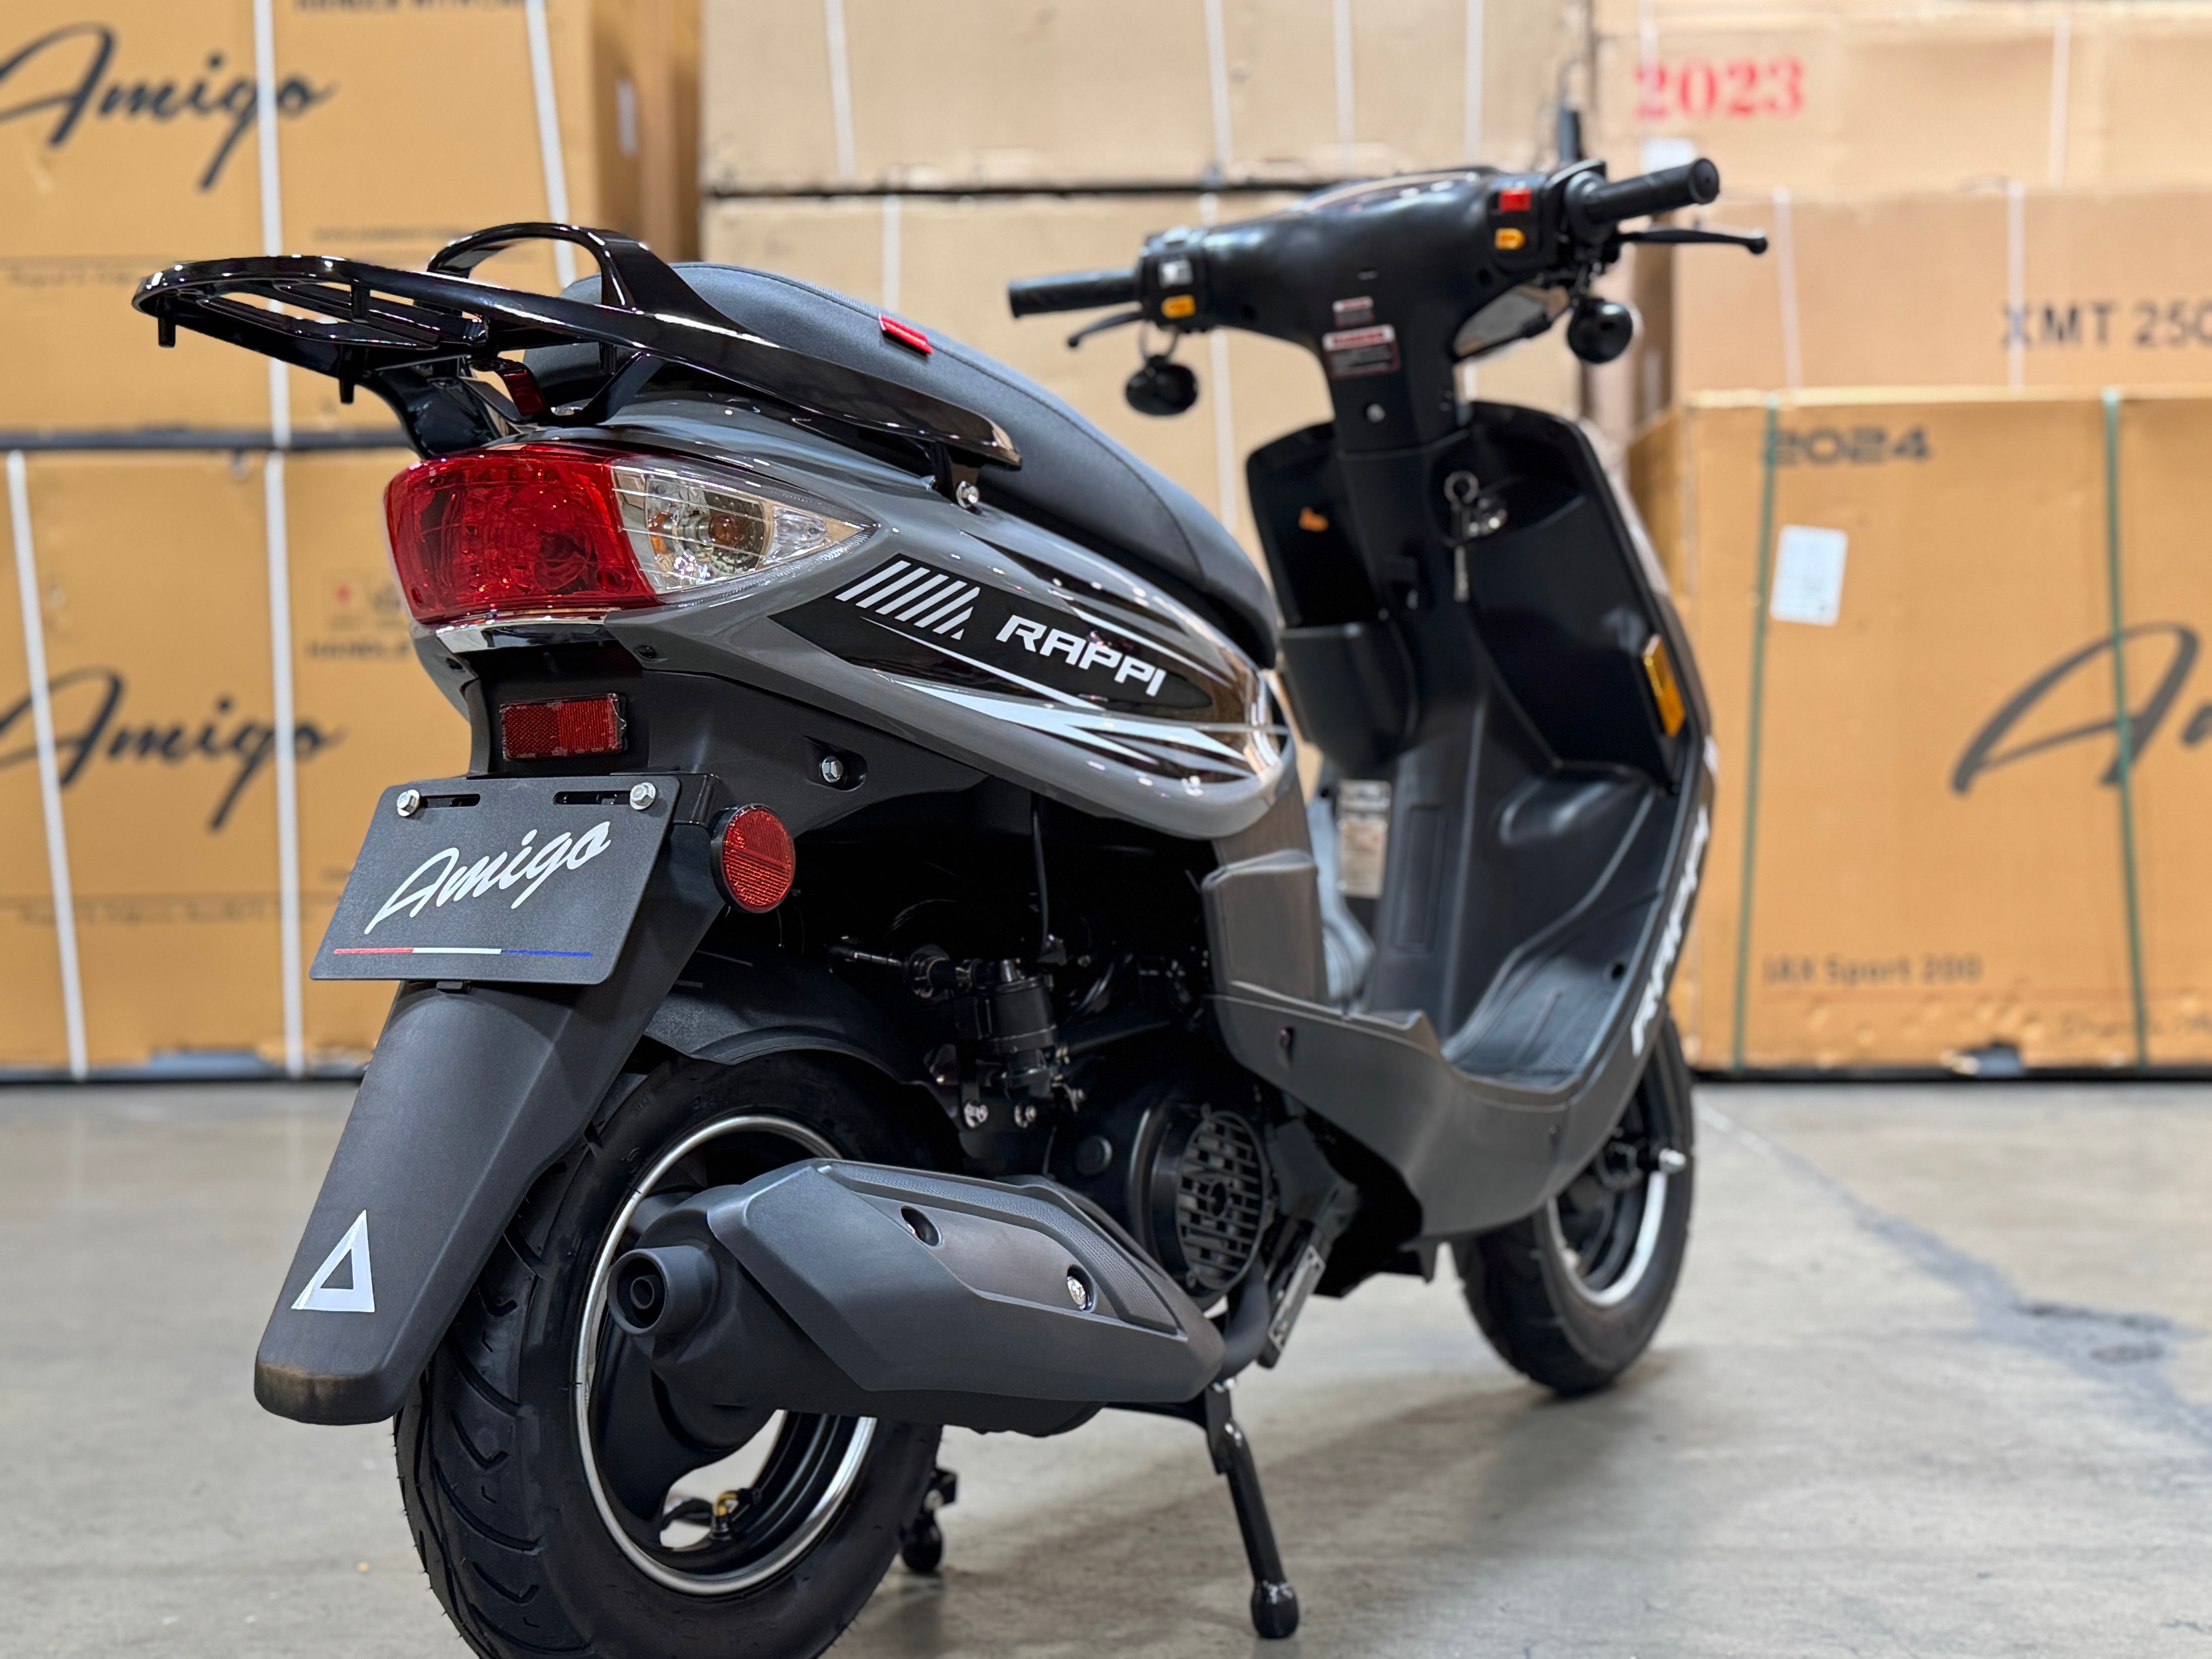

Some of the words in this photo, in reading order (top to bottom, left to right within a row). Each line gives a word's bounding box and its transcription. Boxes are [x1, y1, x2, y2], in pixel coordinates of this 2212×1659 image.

[0, 24, 335, 190] Amigo
[1635, 57, 1804, 119] 2023
[1764, 425, 1931, 466] 2024
[996, 615, 1166, 697] RAPPI
[0, 668, 343, 833] Amigo
[364, 821, 611, 935] Amigo
